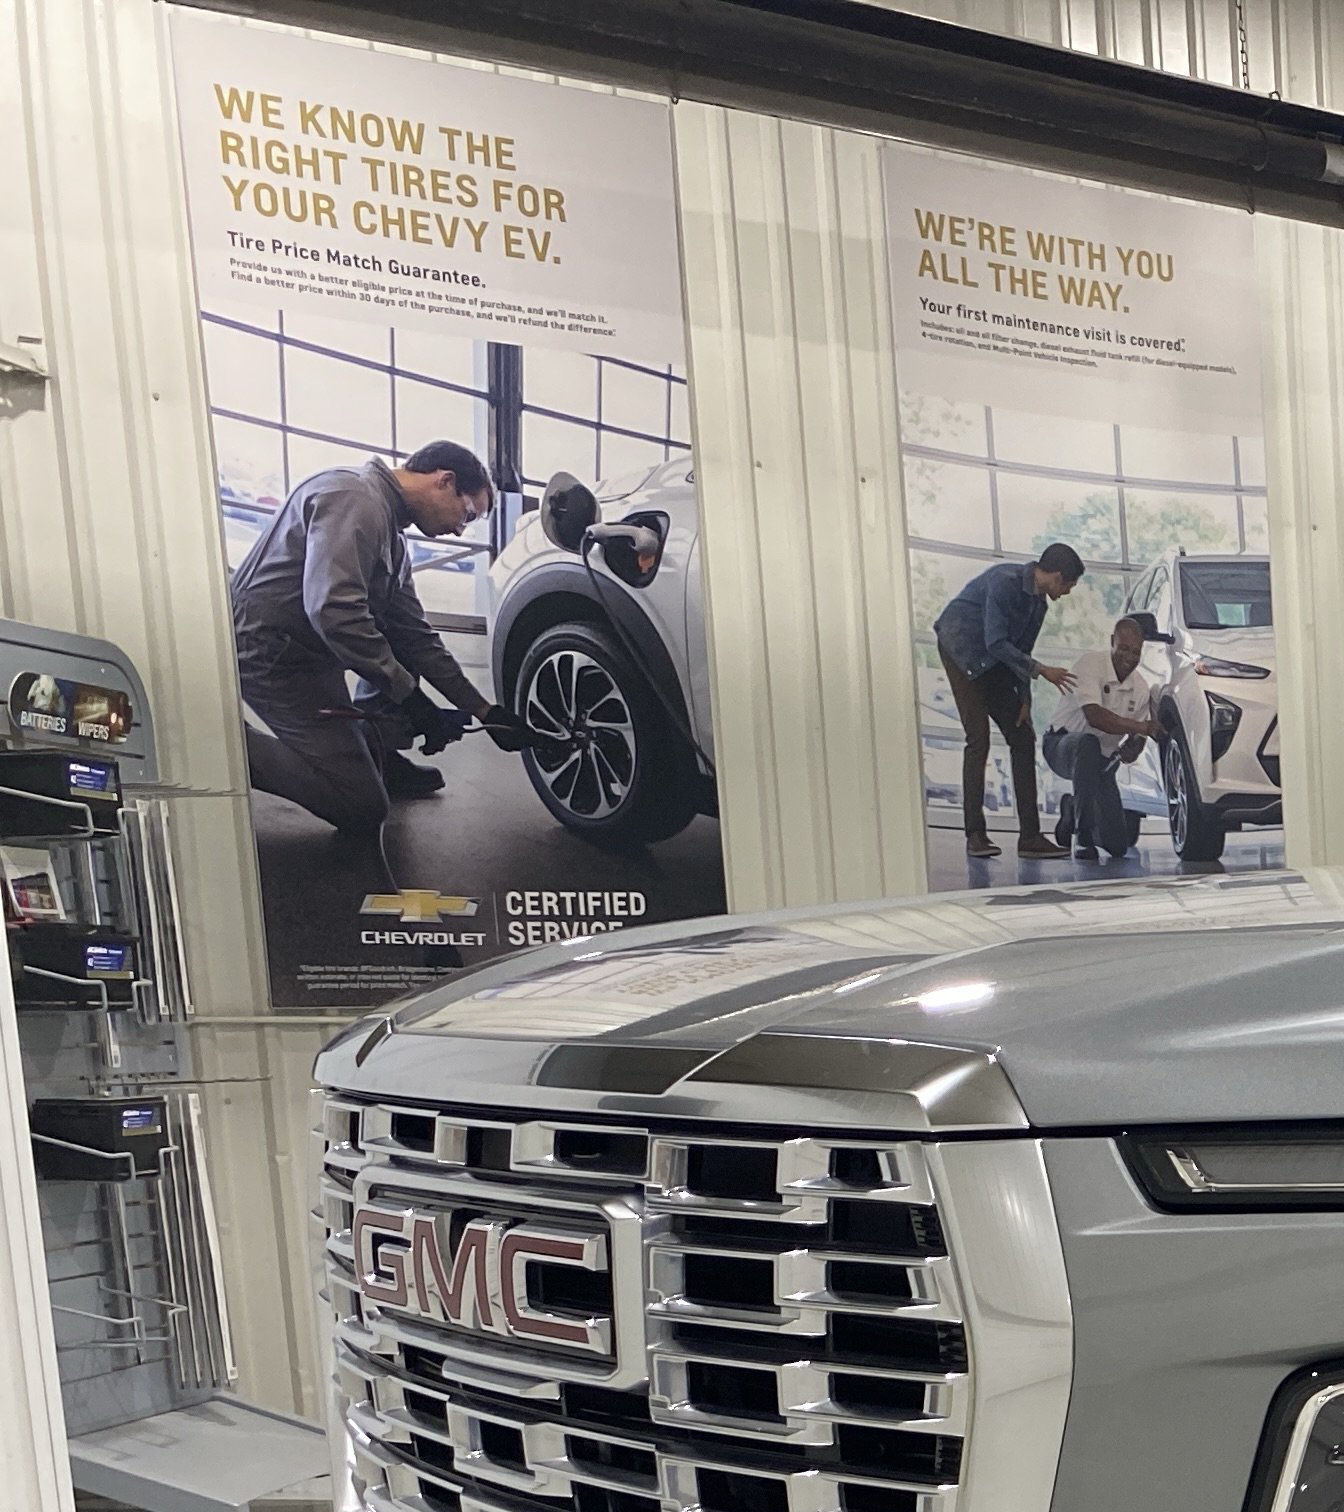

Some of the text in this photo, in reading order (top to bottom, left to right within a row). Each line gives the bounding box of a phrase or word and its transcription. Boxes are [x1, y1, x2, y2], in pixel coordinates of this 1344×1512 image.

[213, 83, 517, 171] WE KNOW THE
[219, 130, 567, 223] RIGHT TIRES FOR
[222, 175, 561, 265] YOUR CHEVY EV.
[914, 207, 1174, 283] WE'RE WITH YOU
[226, 230, 487, 289] Tire Price Match Guarantee.
[917, 248, 1130, 314] ALL THE WAY.
[919, 295, 953, 316] Your
[956, 303, 988, 324] first
[992, 311, 1080, 340] maintenance
[1083, 326, 1112, 343] visit
[1115, 329, 1126, 345] is
[20, 710, 67, 733] BATTERIES
[78, 721, 110, 740] WIPERS
[504, 890, 648, 917] CERTIFIED
[360, 930, 487, 946] CHEVROLET
[352, 1205, 611, 1356] GMC
